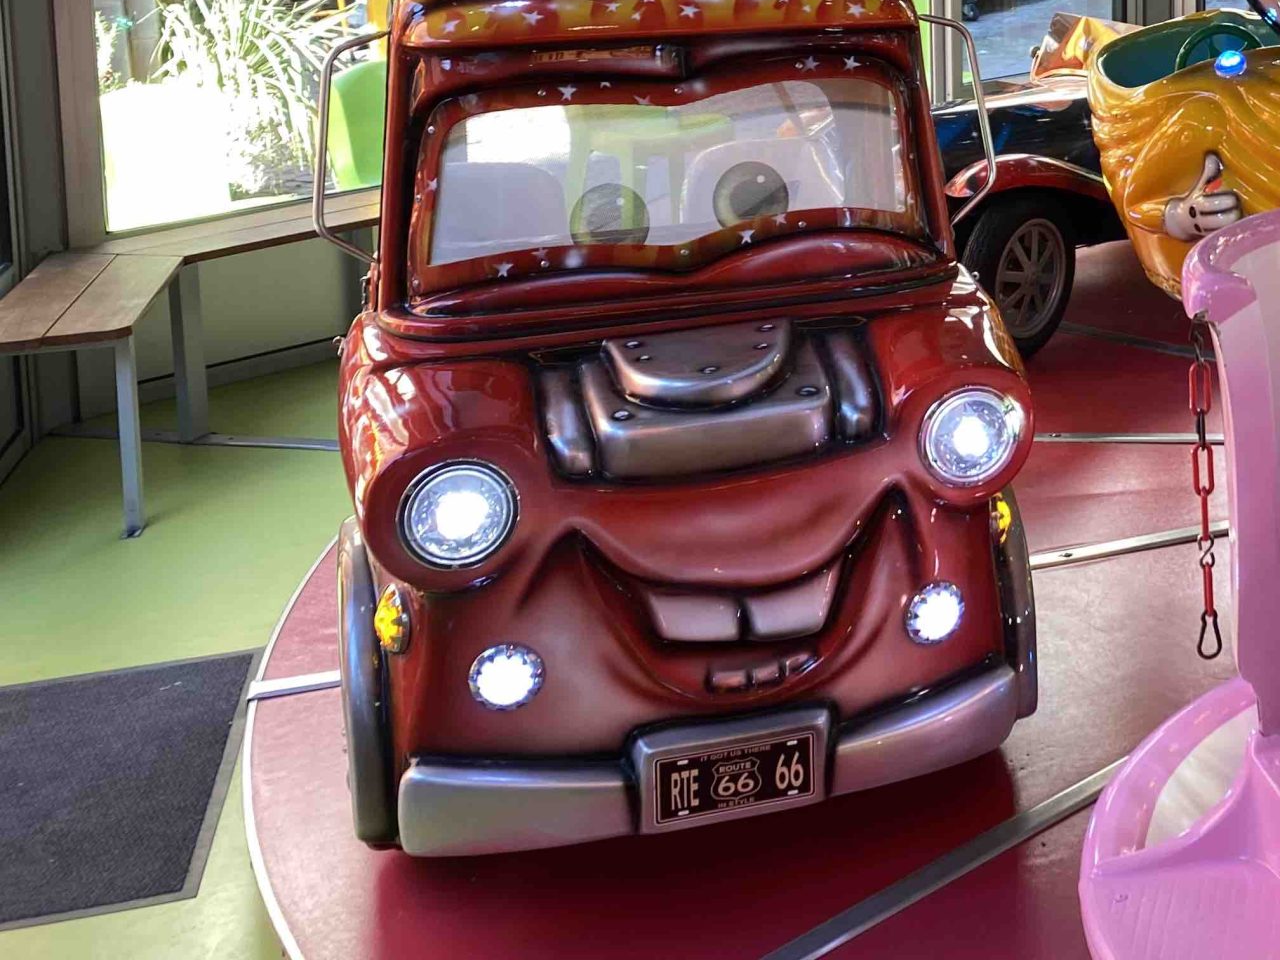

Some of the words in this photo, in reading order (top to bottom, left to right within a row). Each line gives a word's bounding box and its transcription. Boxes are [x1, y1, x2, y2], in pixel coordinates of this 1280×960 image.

[744, 745, 771, 754] THERE
[719, 761, 752, 773] ROUTE
[671, 768, 700, 811] RTE
[775, 751, 804, 790] 66
[718, 772, 755, 796] 66
[728, 797, 755, 808] STYLE
